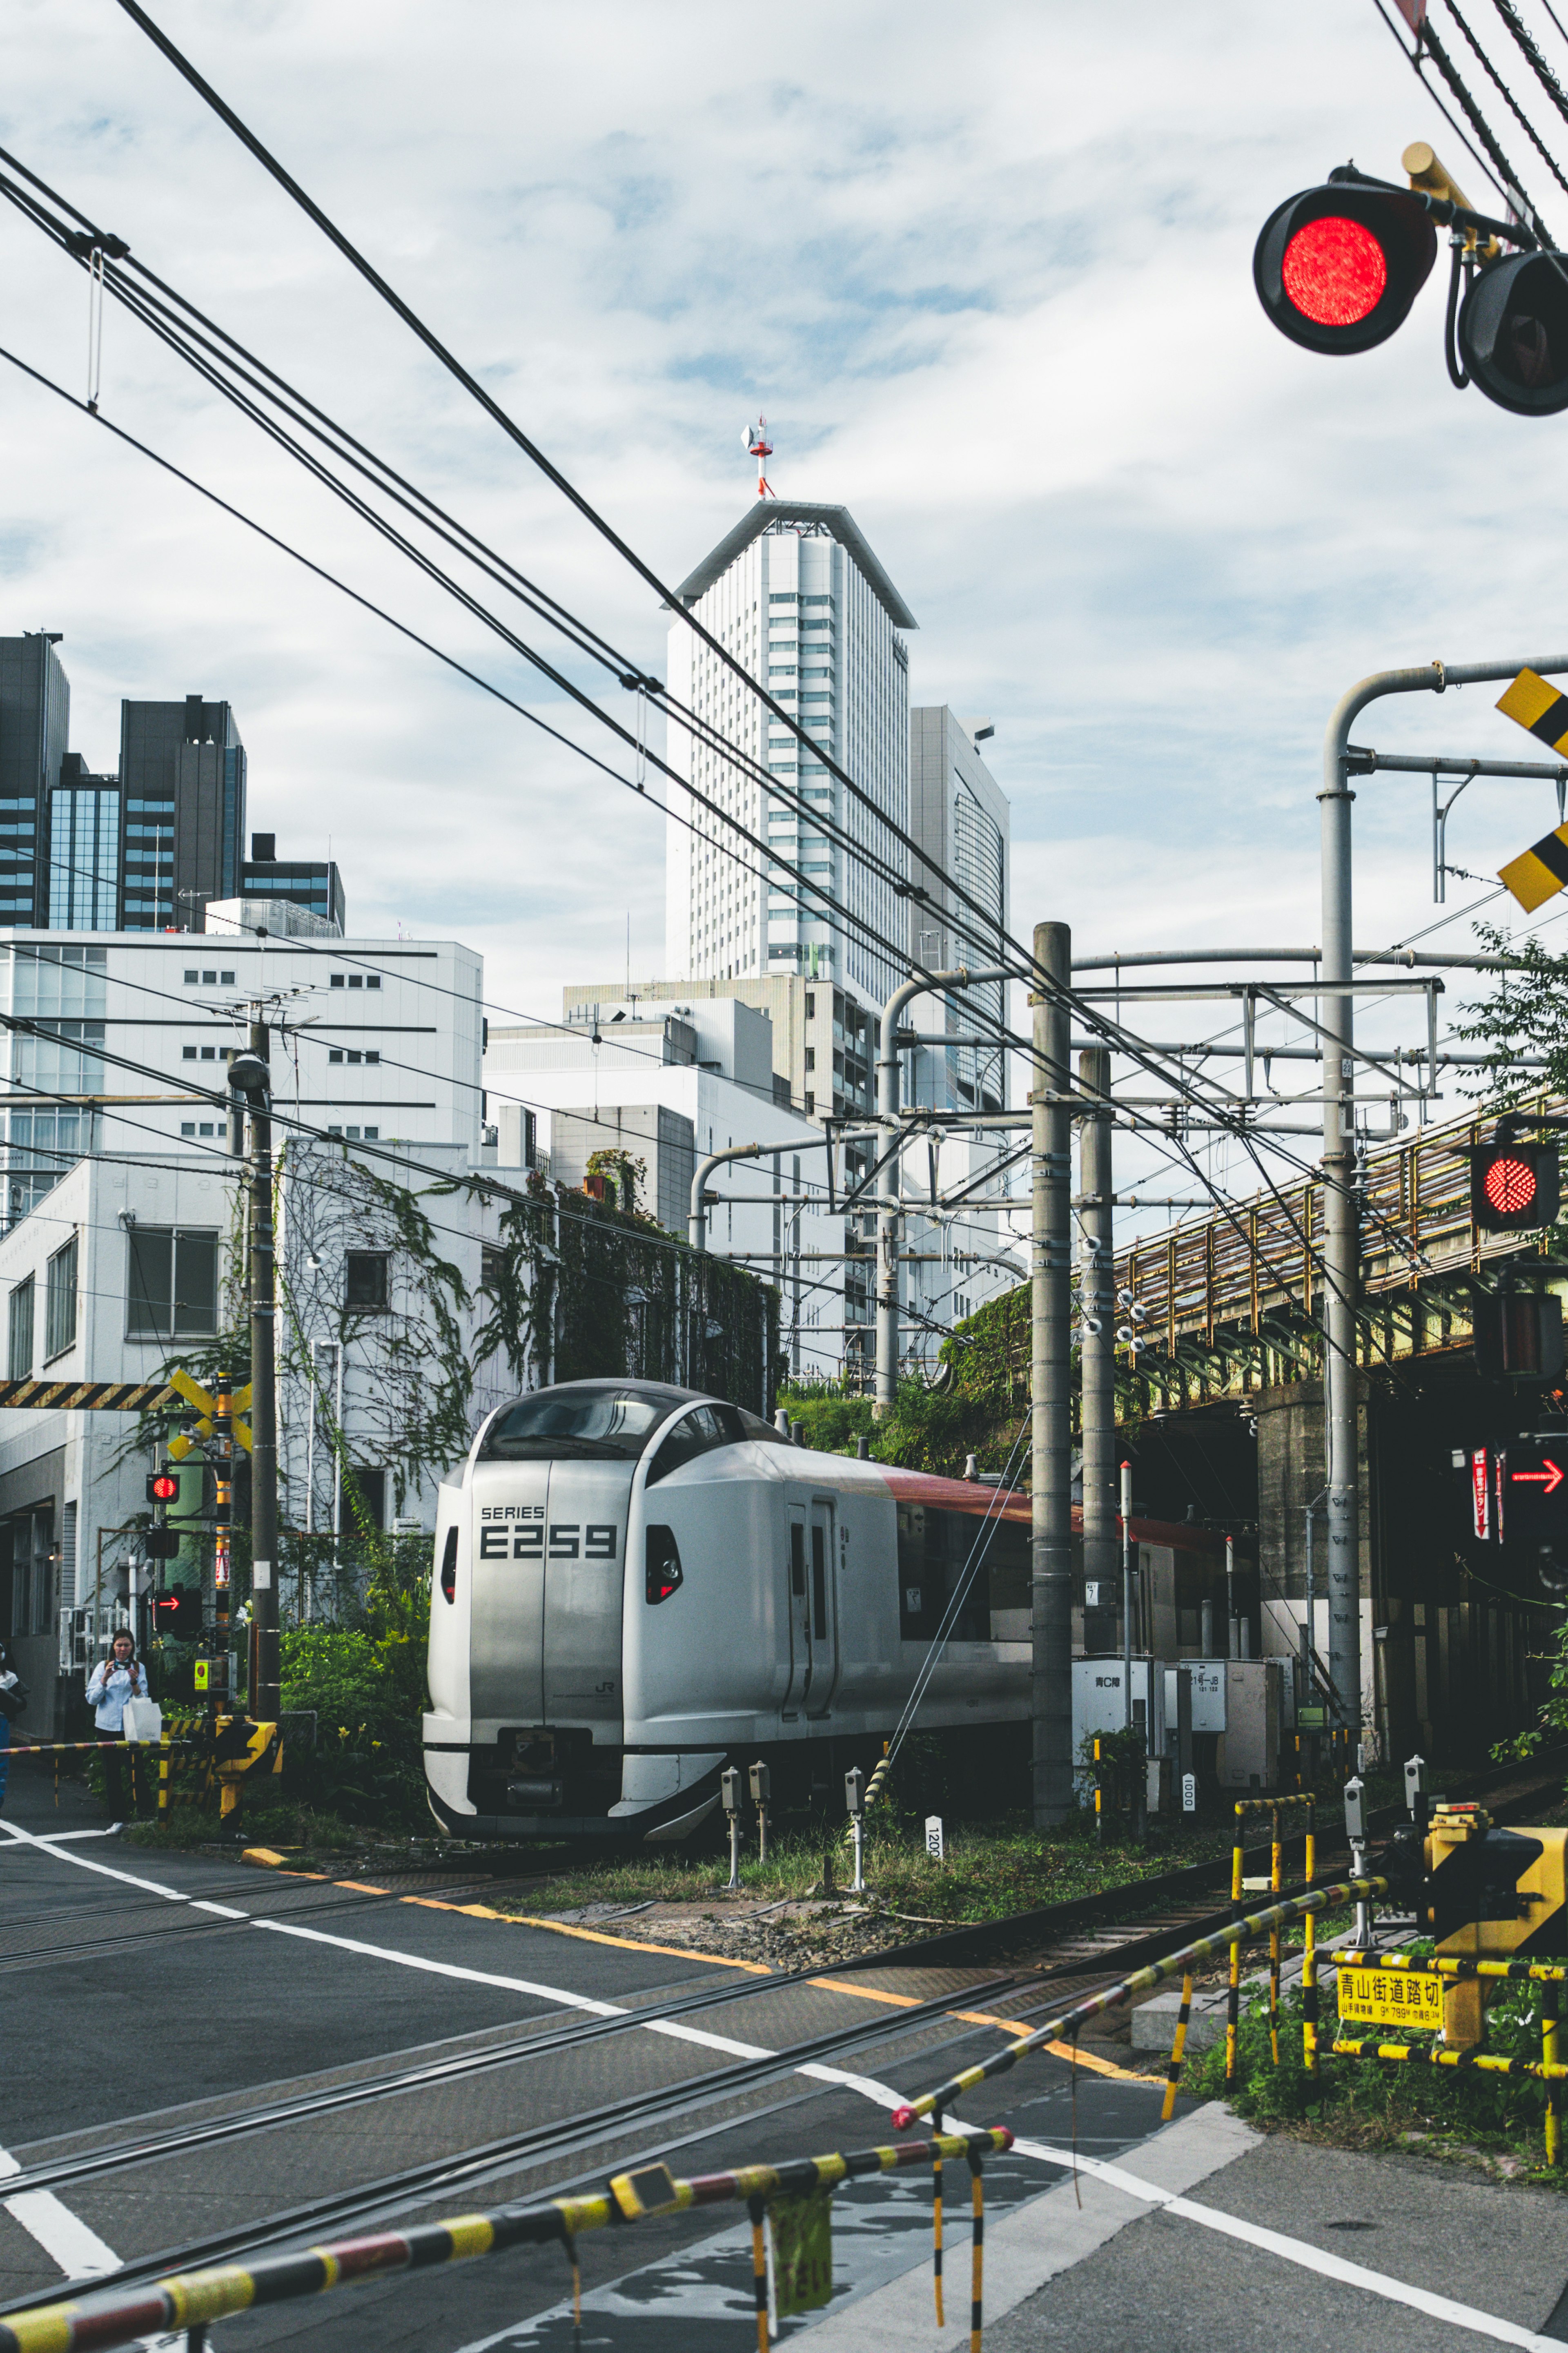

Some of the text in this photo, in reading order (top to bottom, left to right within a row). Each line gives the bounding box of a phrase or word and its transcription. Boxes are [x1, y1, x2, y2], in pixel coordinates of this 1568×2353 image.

[1343, 1064, 1351, 1072] 22
[481, 1506, 544, 1519] SERIES
[480, 1524, 617, 1559] E259
[1089, 1590, 1093, 1598] 7
[595, 1682, 615, 1693] JR
[1185, 1780, 1193, 1806] 1000
[929, 1827, 940, 1857] 1200
[1341, 1973, 1439, 2007] 青山街道踏切
